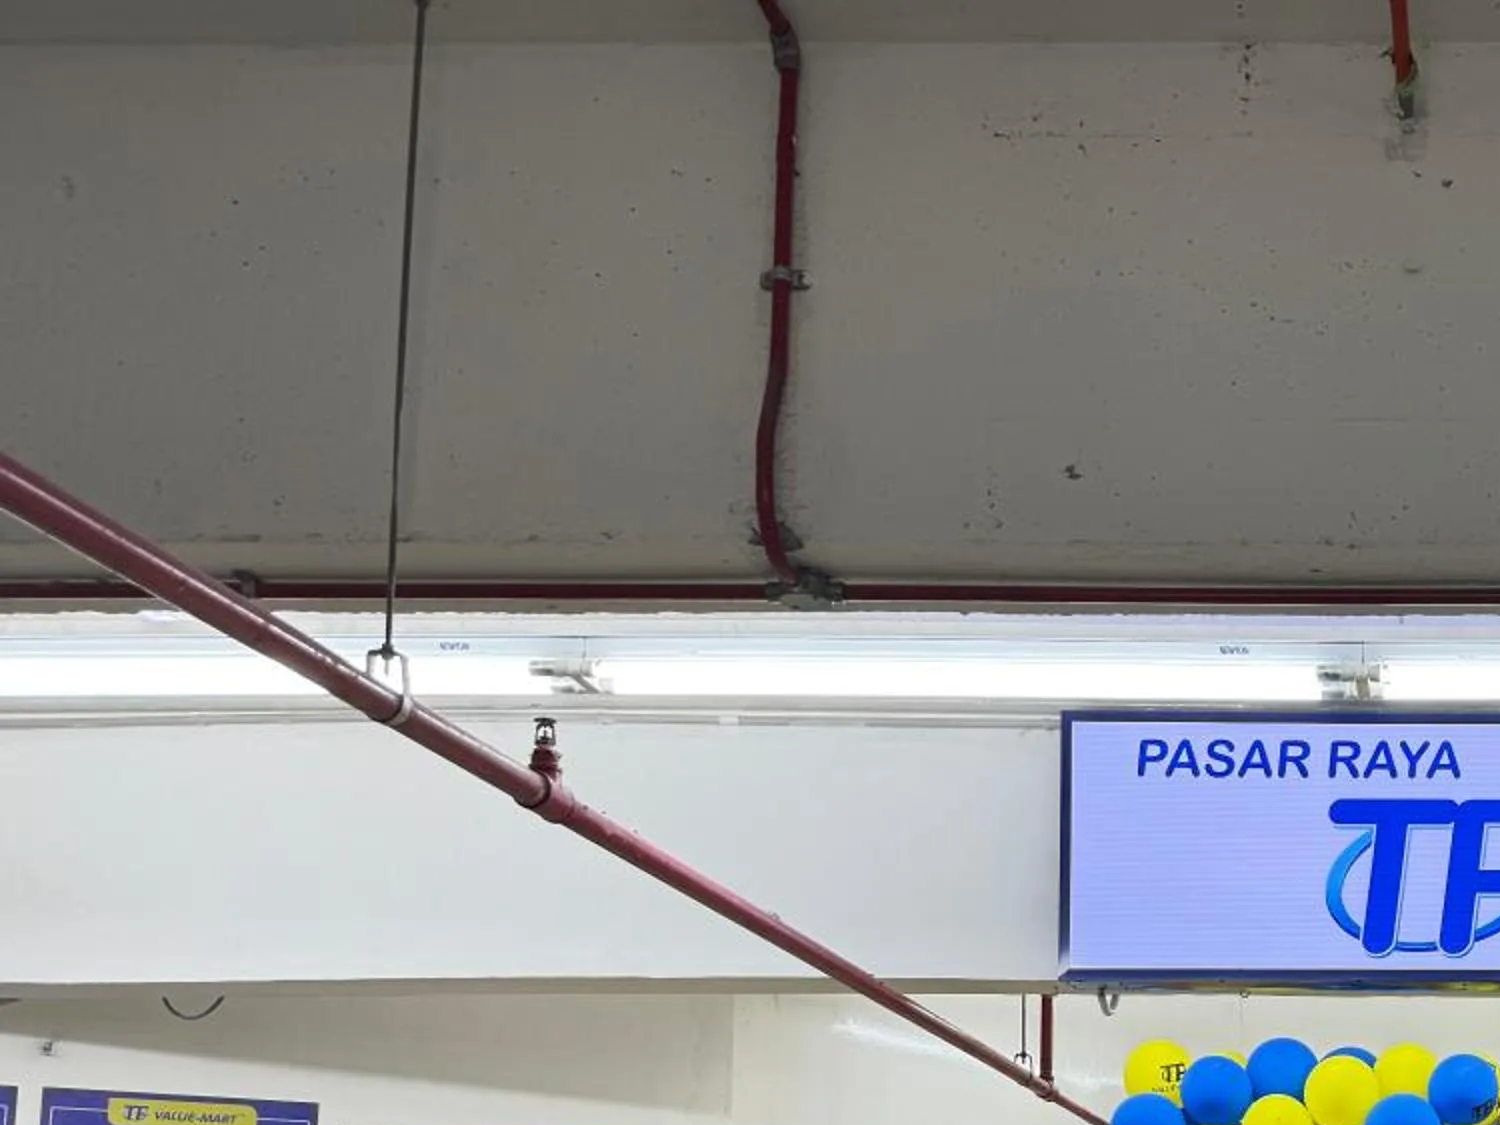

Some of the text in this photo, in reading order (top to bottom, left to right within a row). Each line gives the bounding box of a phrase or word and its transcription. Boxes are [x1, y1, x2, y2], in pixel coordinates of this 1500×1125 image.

[1137, 738, 1461, 779] PASAR RAYA
[155, 1111, 237, 1124] VALUE-MART
